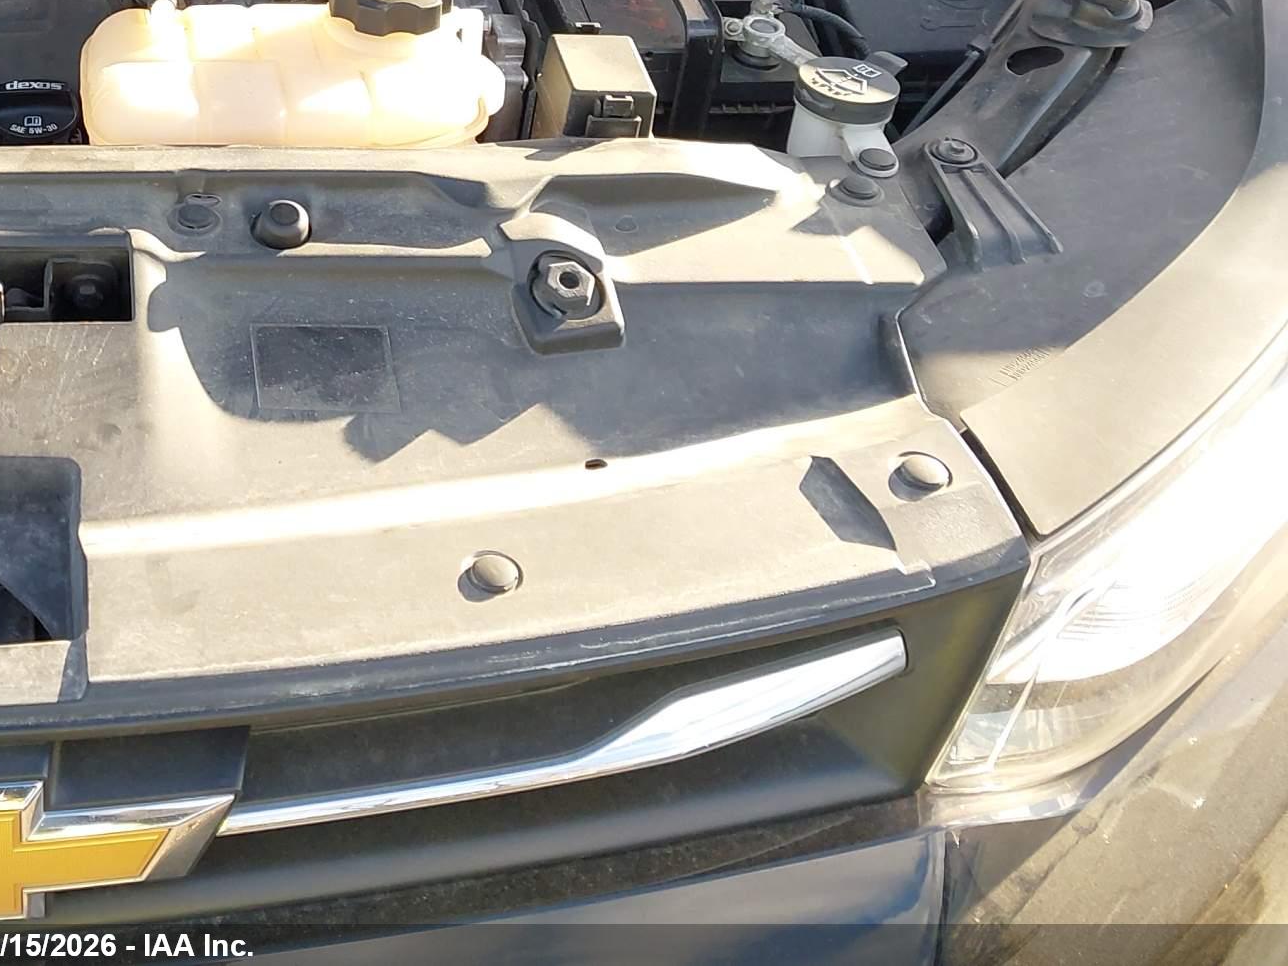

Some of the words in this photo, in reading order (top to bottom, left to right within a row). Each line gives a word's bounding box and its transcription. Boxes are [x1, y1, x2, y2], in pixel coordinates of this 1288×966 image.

[5, 80, 63, 91] dexos
[9, 124, 26, 134] SAE
[28, 123, 58, 135] 5W-30
